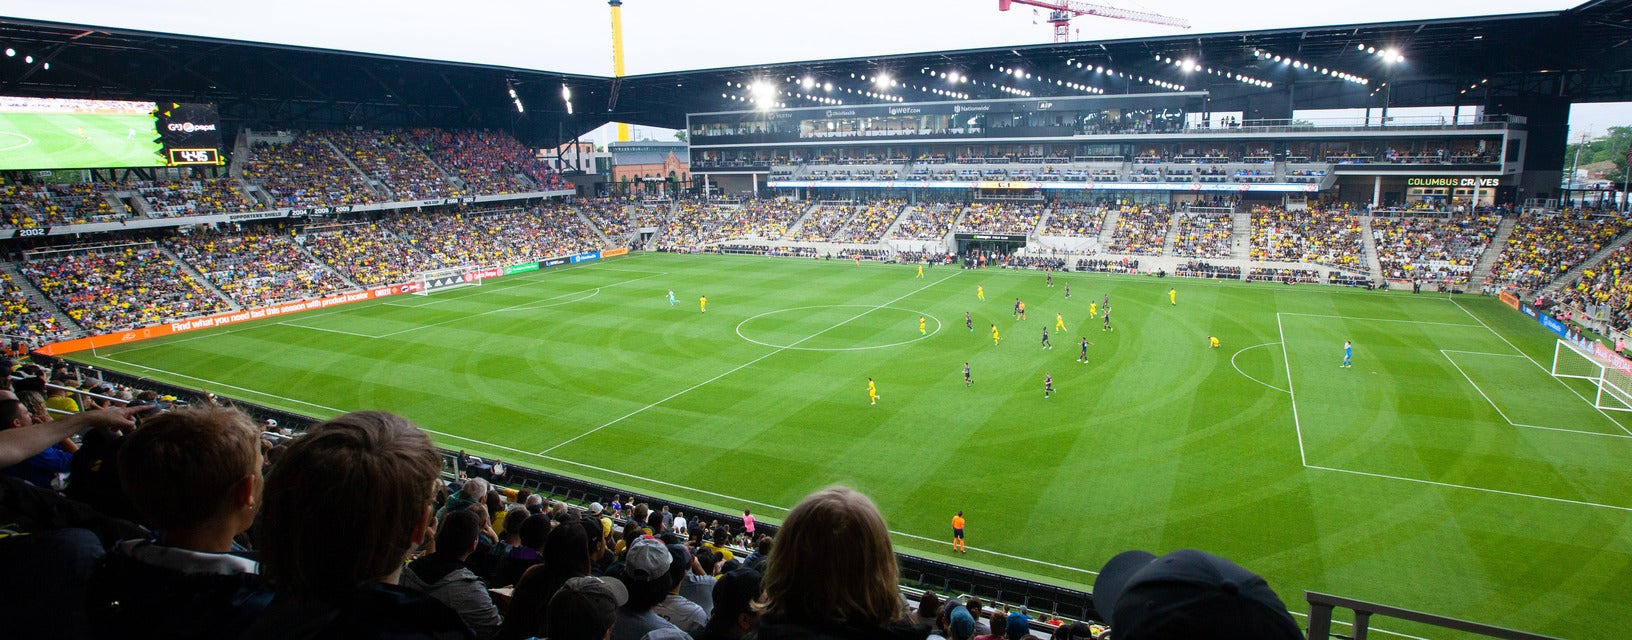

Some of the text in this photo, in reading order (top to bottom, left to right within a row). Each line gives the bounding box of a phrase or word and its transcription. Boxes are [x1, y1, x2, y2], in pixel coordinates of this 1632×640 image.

[181, 150, 209, 162] 4:45
[1407, 178, 1459, 186] COLUMBUS
[20, 228, 45, 237] 2002
[172, 291, 368, 332] Find what you need fast this season with product locator
